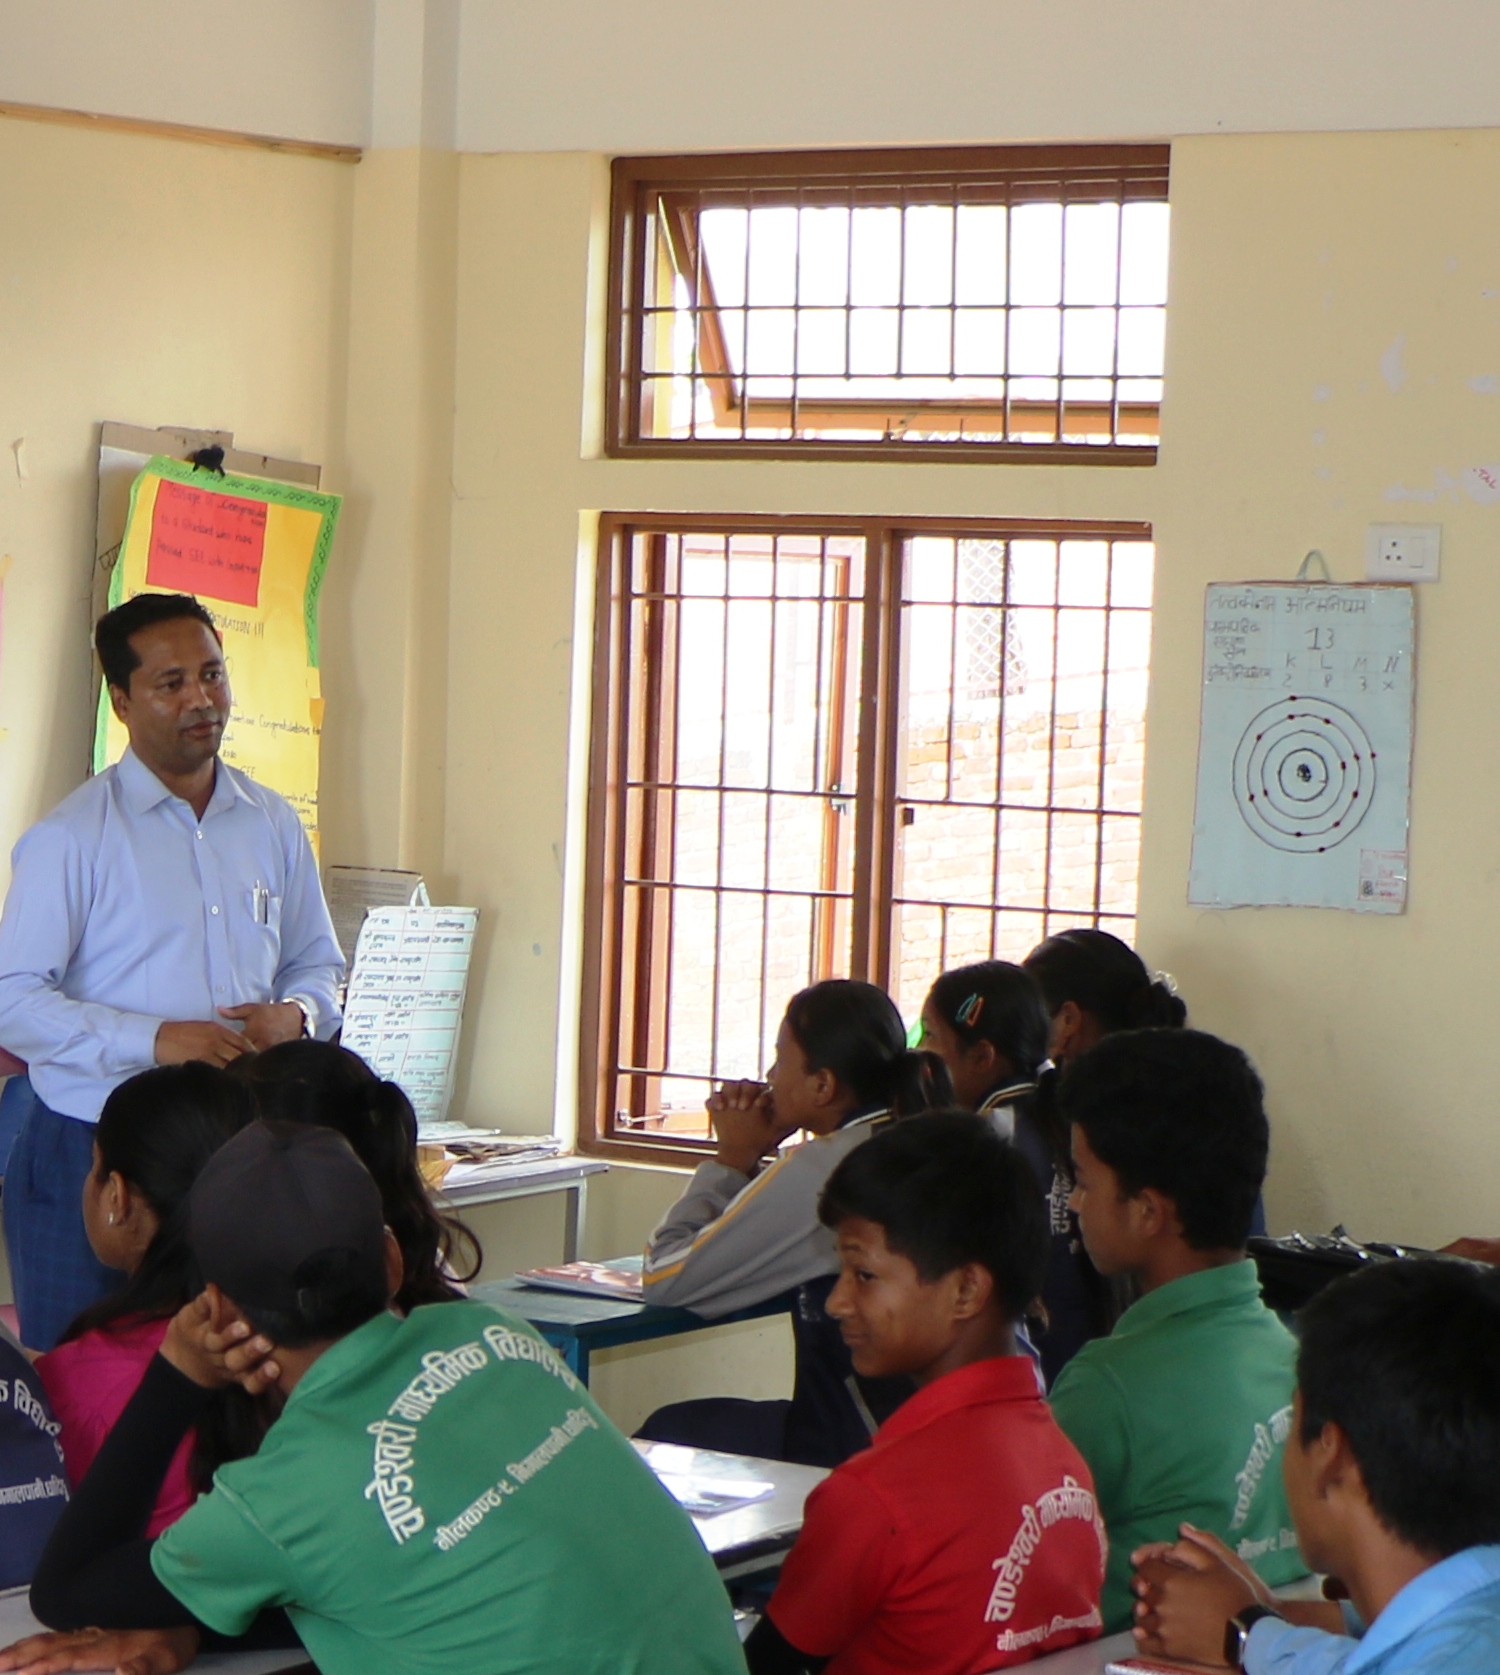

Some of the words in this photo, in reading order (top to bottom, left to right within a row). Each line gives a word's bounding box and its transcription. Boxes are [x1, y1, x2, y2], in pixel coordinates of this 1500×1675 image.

[204, 608, 251, 636] ATULATION
[1304, 626, 1335, 651] 13
[1286, 653, 1297, 669] K
[1320, 654, 1334, 670] L
[1353, 656, 1368, 671] M
[1383, 656, 1400, 673] N
[1282, 674, 1293, 688] 2
[1359, 676, 1368, 691] 3
[387, 1341, 489, 1422] माध्यमिक
[365, 1419, 426, 1545] चण्डेश्वरी
[983, 1503, 1042, 1623] चण्डेश्वरी
[1035, 1474, 1096, 1529] माध्यमिक
